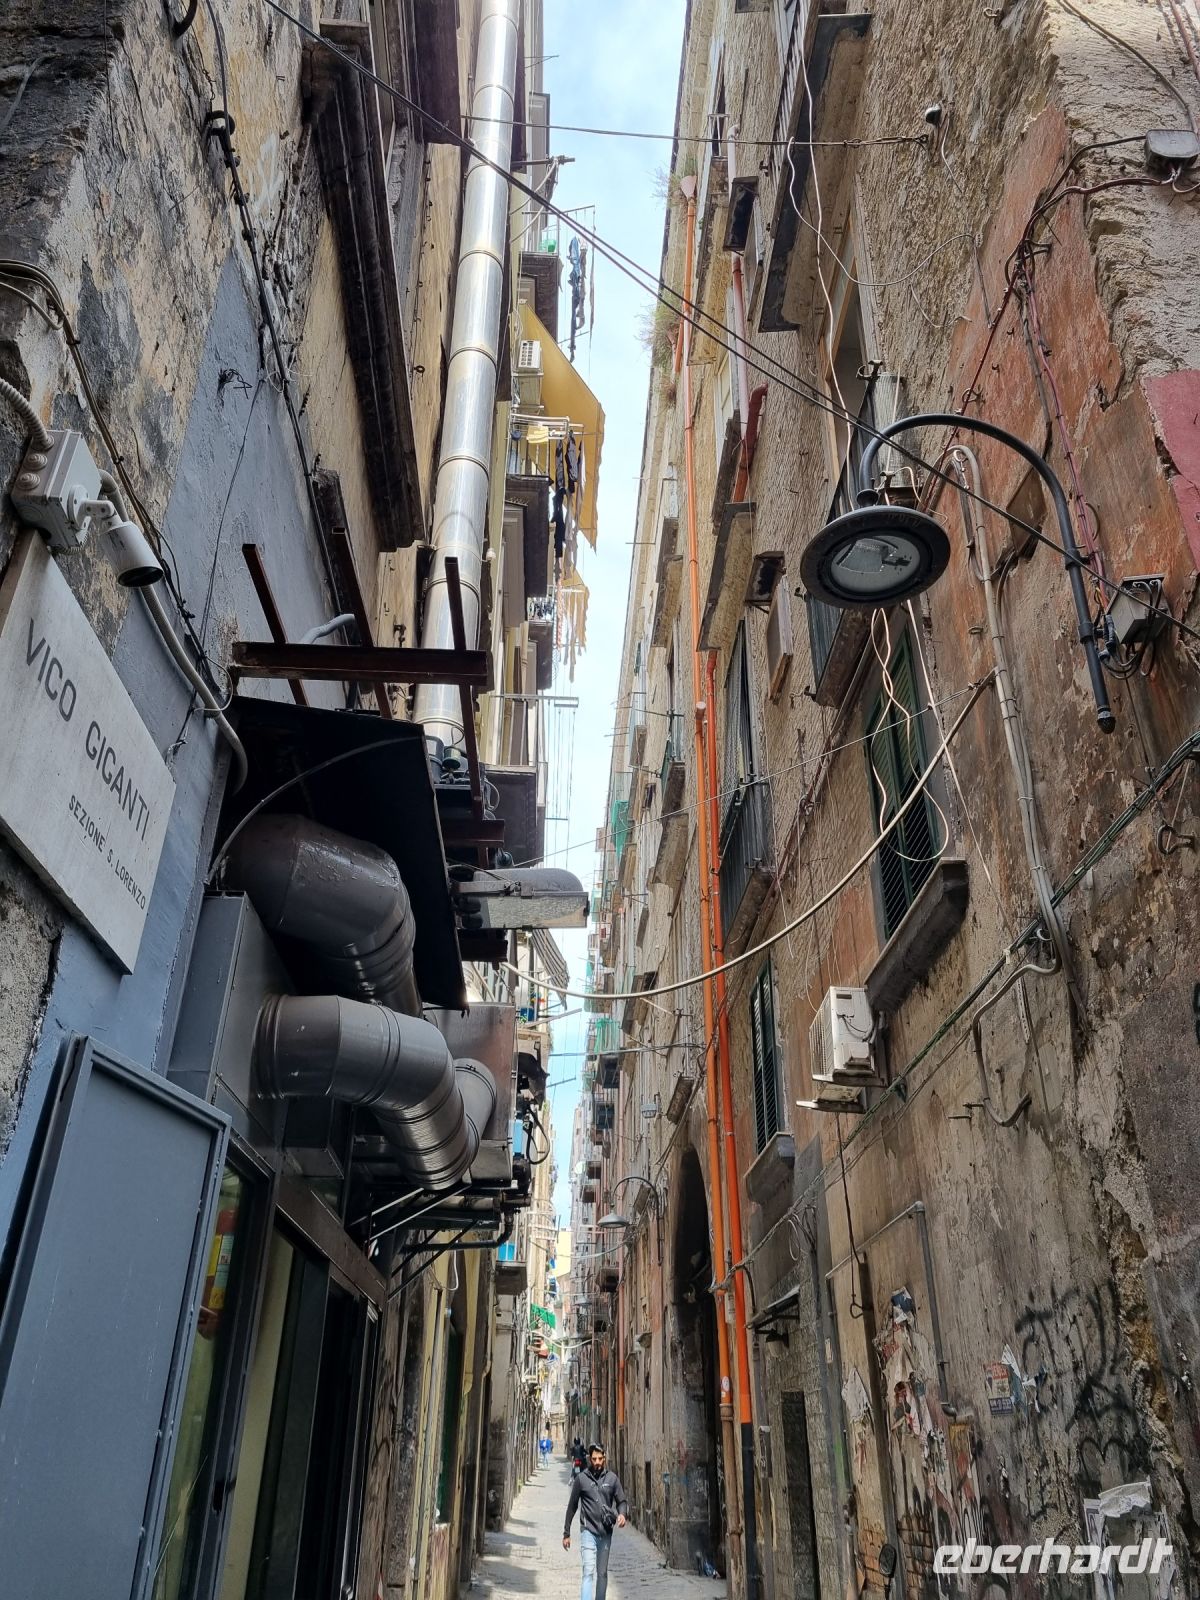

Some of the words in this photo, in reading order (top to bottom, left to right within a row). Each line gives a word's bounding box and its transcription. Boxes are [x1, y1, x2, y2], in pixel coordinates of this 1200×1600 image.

[26, 618, 77, 722] VICO
[85, 720, 150, 841] GIGANTI
[69, 794, 105, 853] SEZIONE
[107, 848, 114, 868] S.
[114, 859, 146, 910] LORENZO
